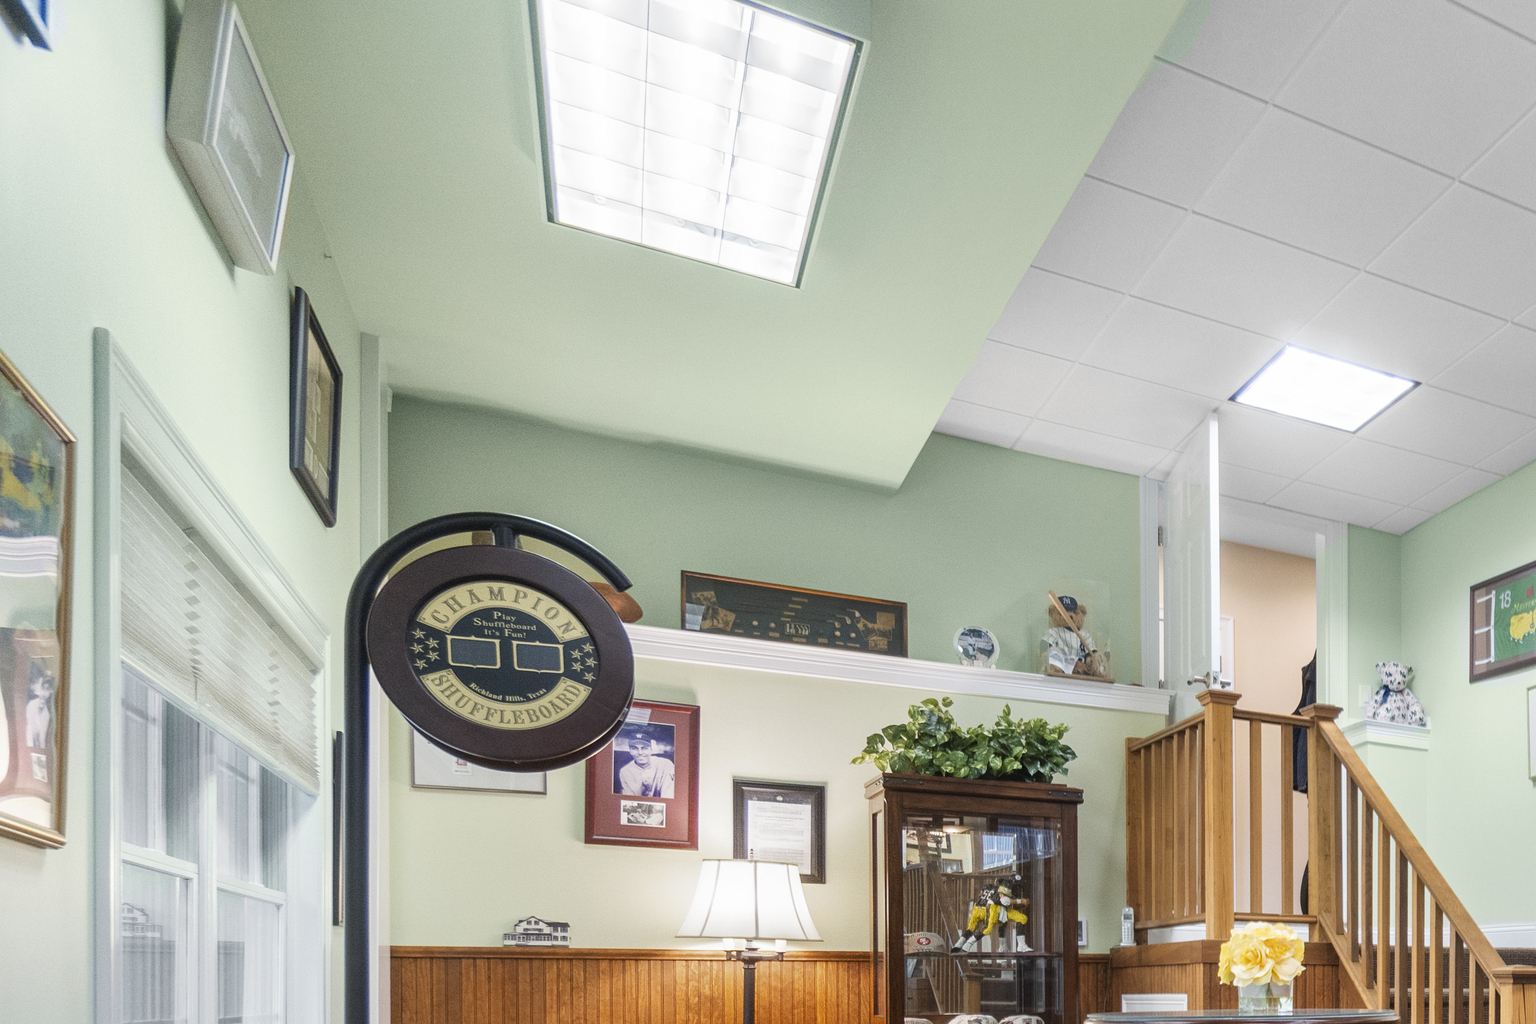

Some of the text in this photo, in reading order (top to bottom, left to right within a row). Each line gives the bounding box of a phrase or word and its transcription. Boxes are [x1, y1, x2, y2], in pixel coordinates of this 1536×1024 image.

[1499, 591, 1512, 609] 18
[431, 585, 578, 637] CHAMPION
[493, 611, 517, 622] Play
[473, 617, 537, 631] Shuffleboard
[484, 628, 527, 639] It's Fun!
[431, 674, 582, 725] SHUFFLEBOARD
[469, 682, 503, 701] Richland
[527, 688, 547, 700] Texas
